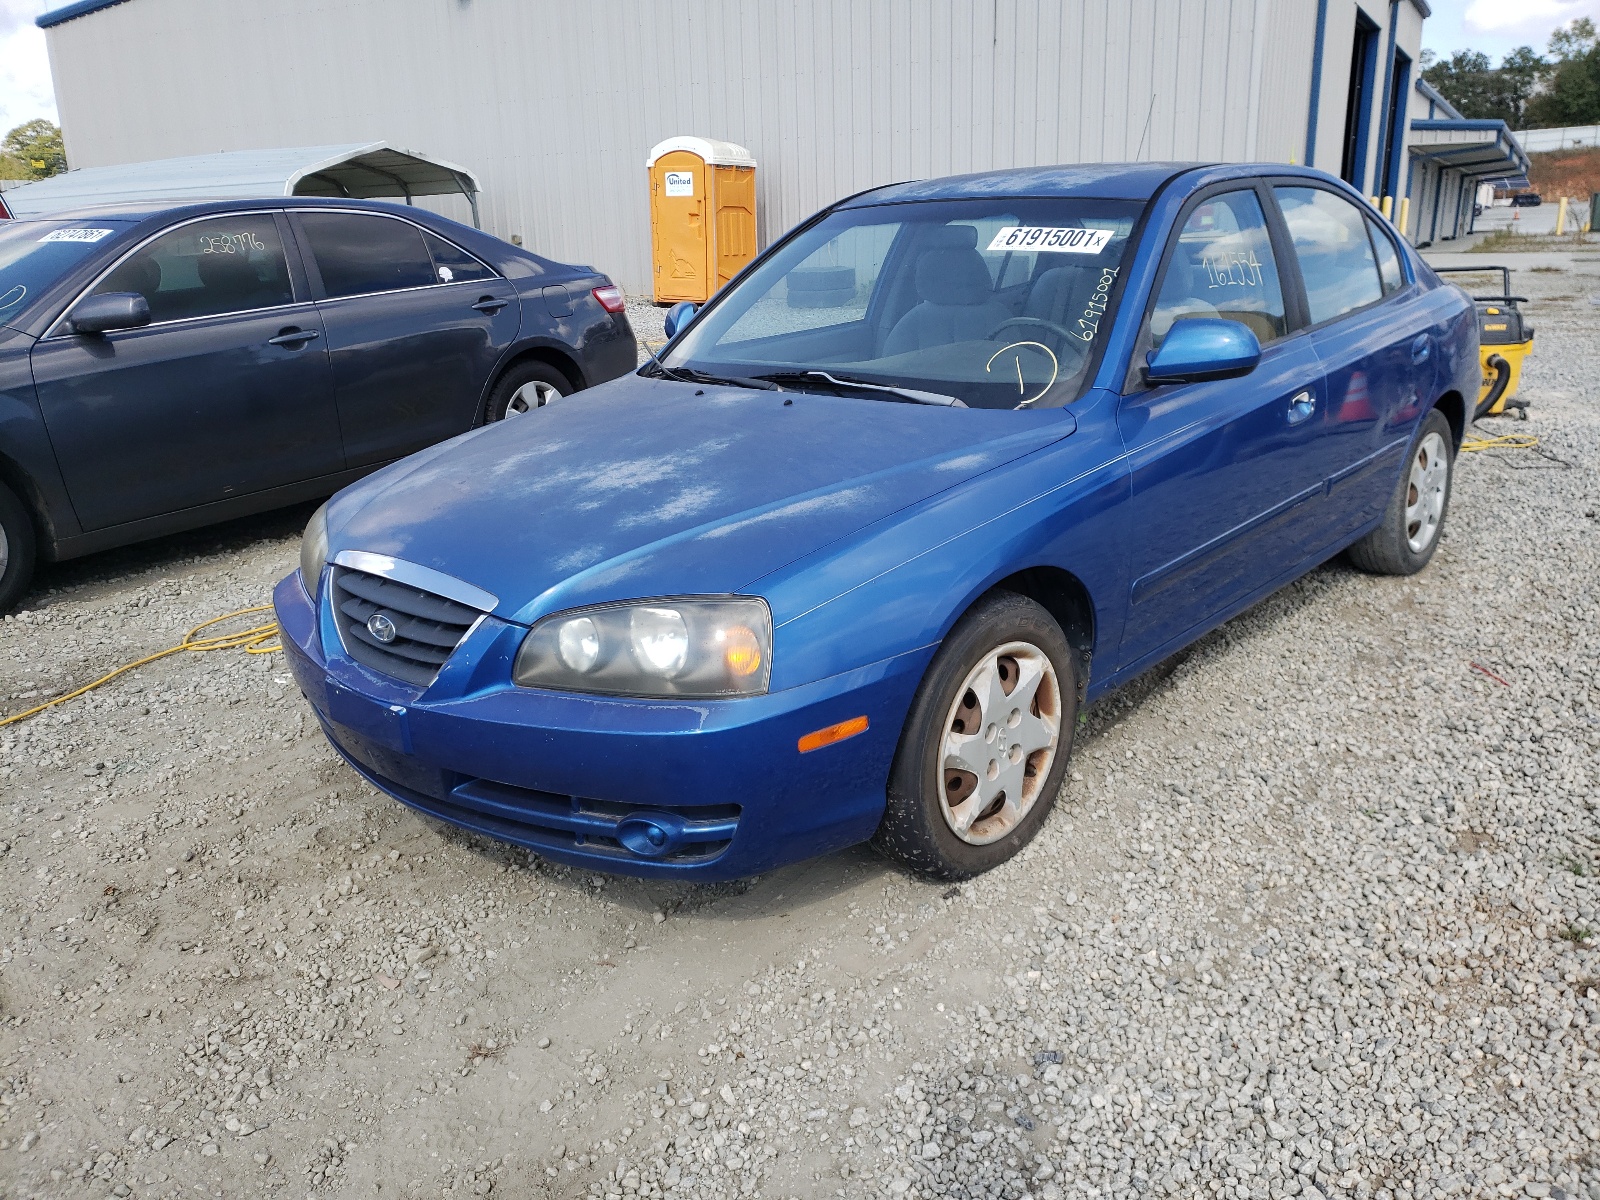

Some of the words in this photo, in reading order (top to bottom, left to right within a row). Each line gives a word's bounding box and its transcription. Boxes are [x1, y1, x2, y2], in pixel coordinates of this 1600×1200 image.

[668, 177, 691, 185] United
[200, 232, 265, 254] 258776
[1006, 228, 1097, 248] 61915001
[1203, 250, 1263, 289] 161554
[1069, 266, 1120, 341] 61915001
